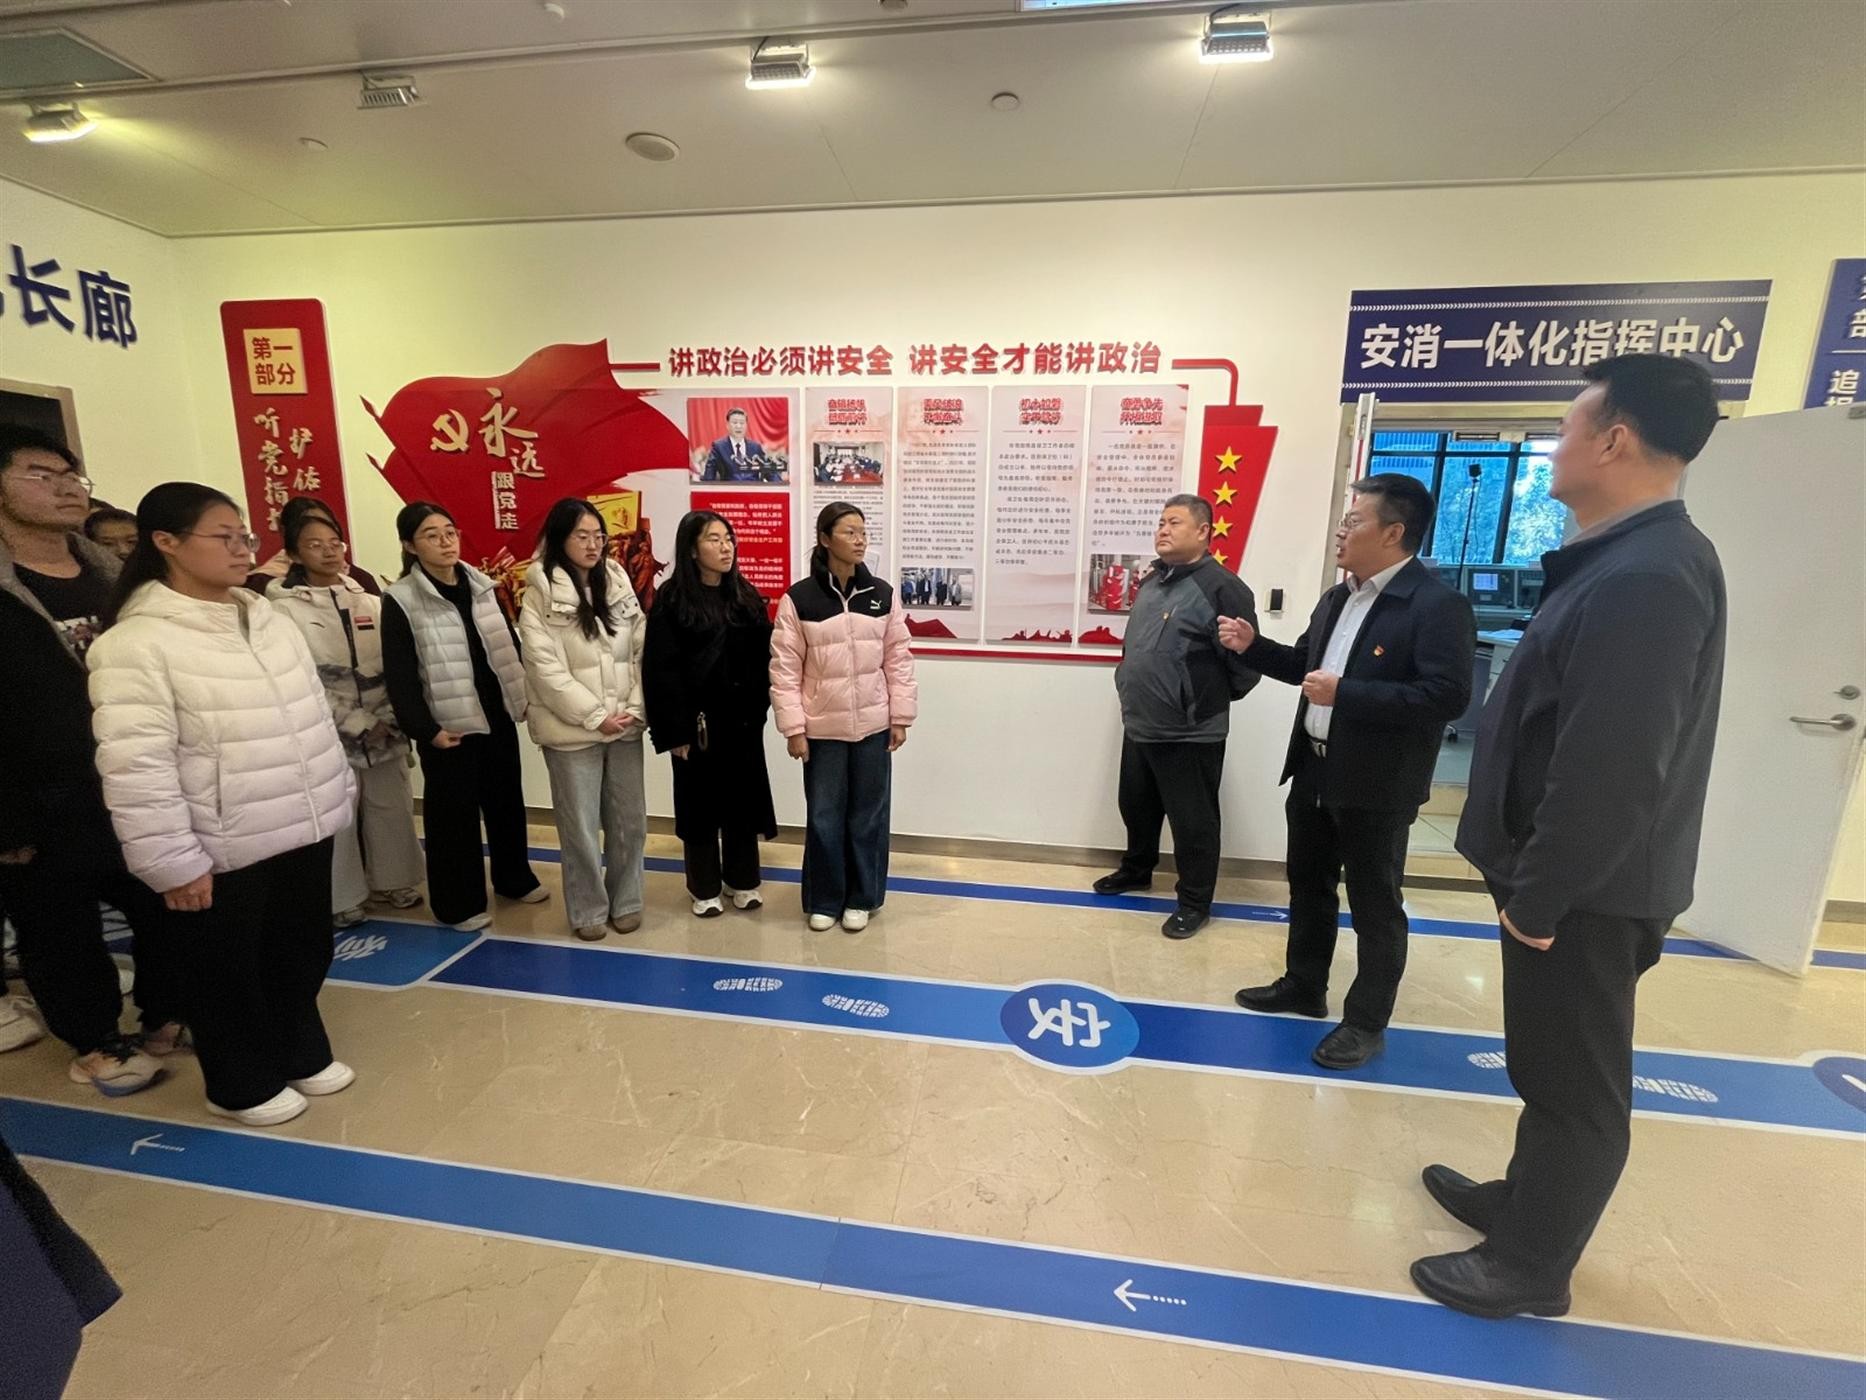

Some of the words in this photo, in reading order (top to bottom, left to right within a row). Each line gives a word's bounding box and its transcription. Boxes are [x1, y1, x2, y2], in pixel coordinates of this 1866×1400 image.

[0, 244, 138, 350] 长廊
[252, 337, 293, 360] 第一
[668, 344, 894, 377] 讲政治必须讲安全
[909, 341, 1162, 375] 讲安全才能讲政治
[1360, 317, 1745, 369] 安消一体化指挥中心
[255, 362, 296, 386] 部分
[478, 387, 546, 478] 永远
[495, 471, 520, 530] 跟党走
[1028, 998, 1111, 1047] 安
